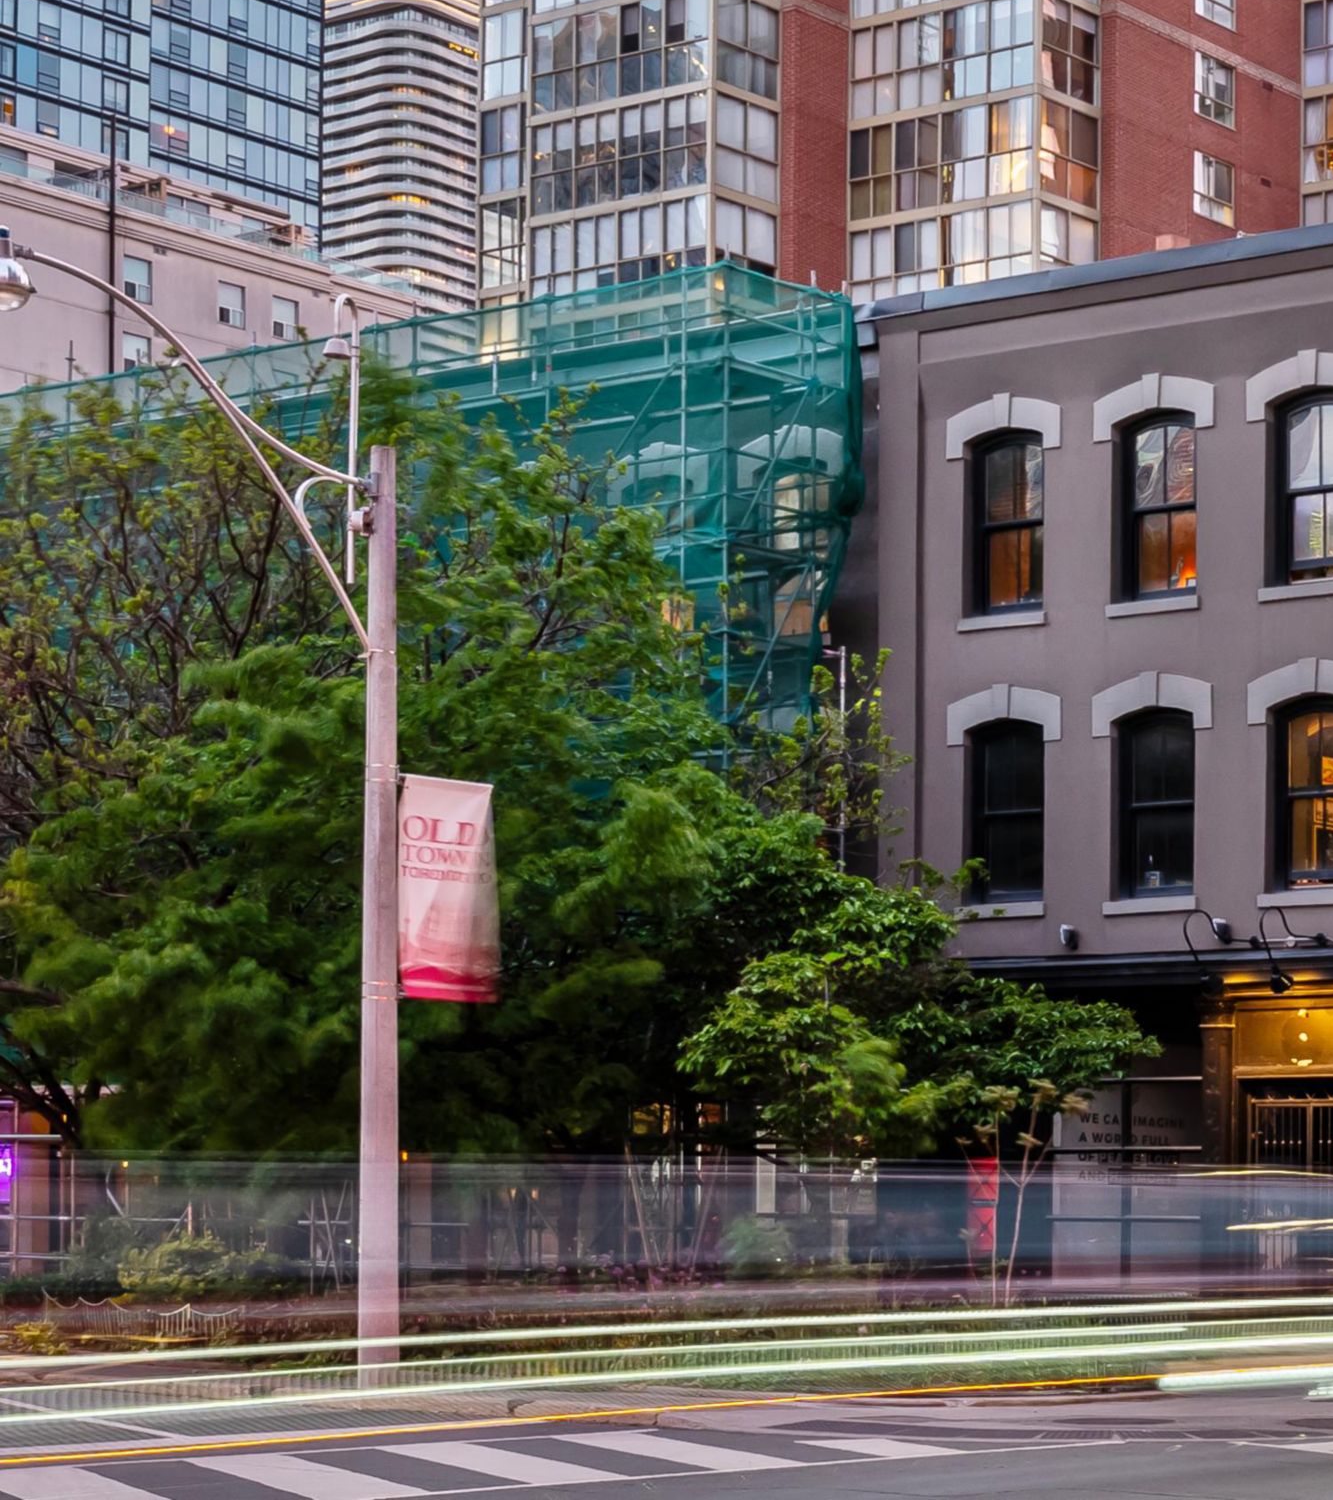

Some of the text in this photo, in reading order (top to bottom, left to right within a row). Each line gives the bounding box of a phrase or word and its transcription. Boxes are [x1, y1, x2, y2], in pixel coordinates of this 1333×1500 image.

[1080, 1113, 1099, 1125] WE
[1103, 1114, 1121, 1125] CA
[1078, 1132, 1169, 1146] A WORD FULL
